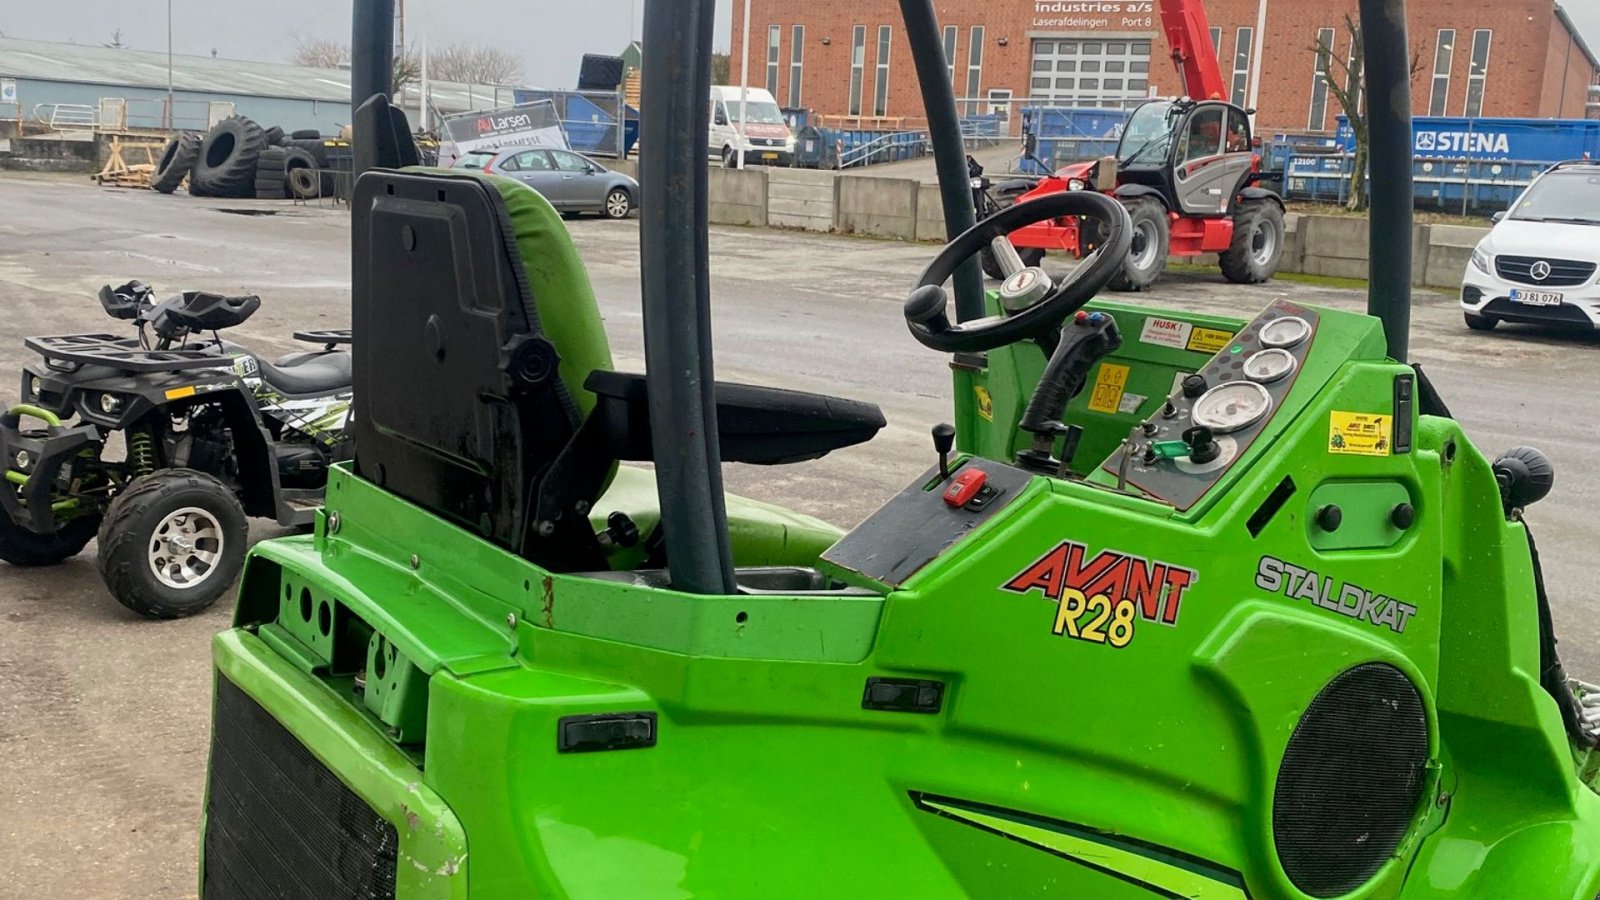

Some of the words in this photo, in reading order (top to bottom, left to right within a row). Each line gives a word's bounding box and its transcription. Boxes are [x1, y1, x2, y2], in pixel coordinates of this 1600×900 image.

[1034, 2, 1121, 13] industries
[1126, 3, 1153, 13] a/s
[1033, 17, 1108, 28] Laserafdelingen
[1122, 17, 1142, 27] Port
[1144, 18, 1152, 27] 8
[1437, 131, 1509, 153] STENA
[1153, 320, 1177, 330] HUSK
[1255, 555, 1418, 634] STALDKAT
[1052, 587, 1137, 649] R28
